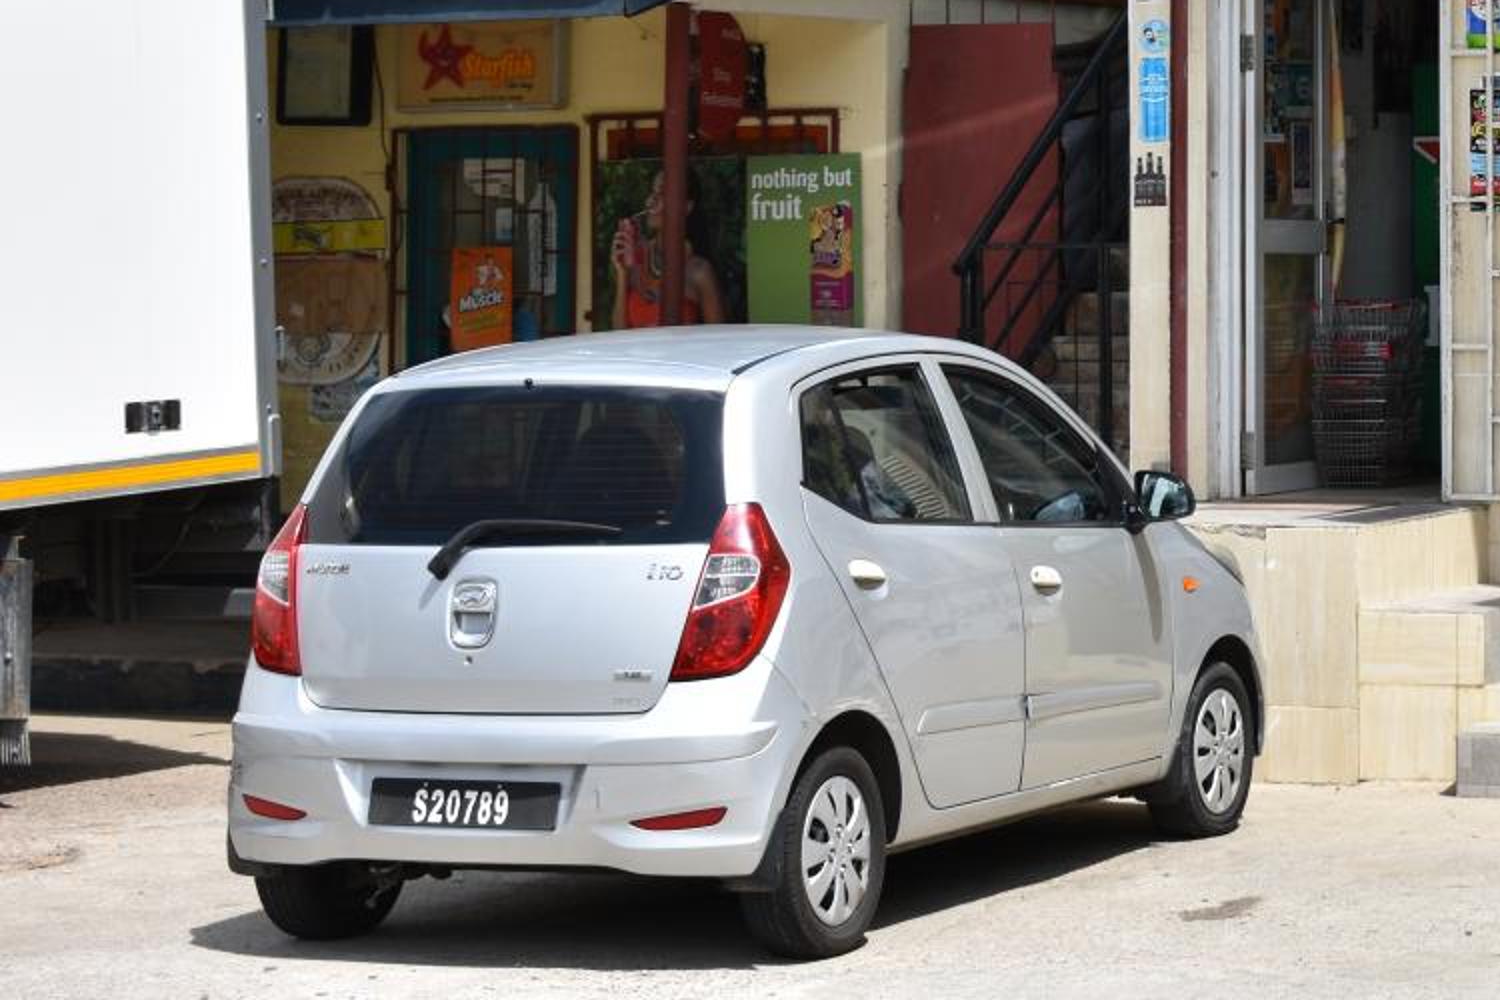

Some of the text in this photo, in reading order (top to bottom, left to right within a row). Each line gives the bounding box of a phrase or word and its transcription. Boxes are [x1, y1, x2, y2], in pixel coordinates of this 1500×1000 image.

[751, 165, 853, 193] nothing but
[751, 193, 803, 221] fruit
[412, 788, 510, 826] S20789
